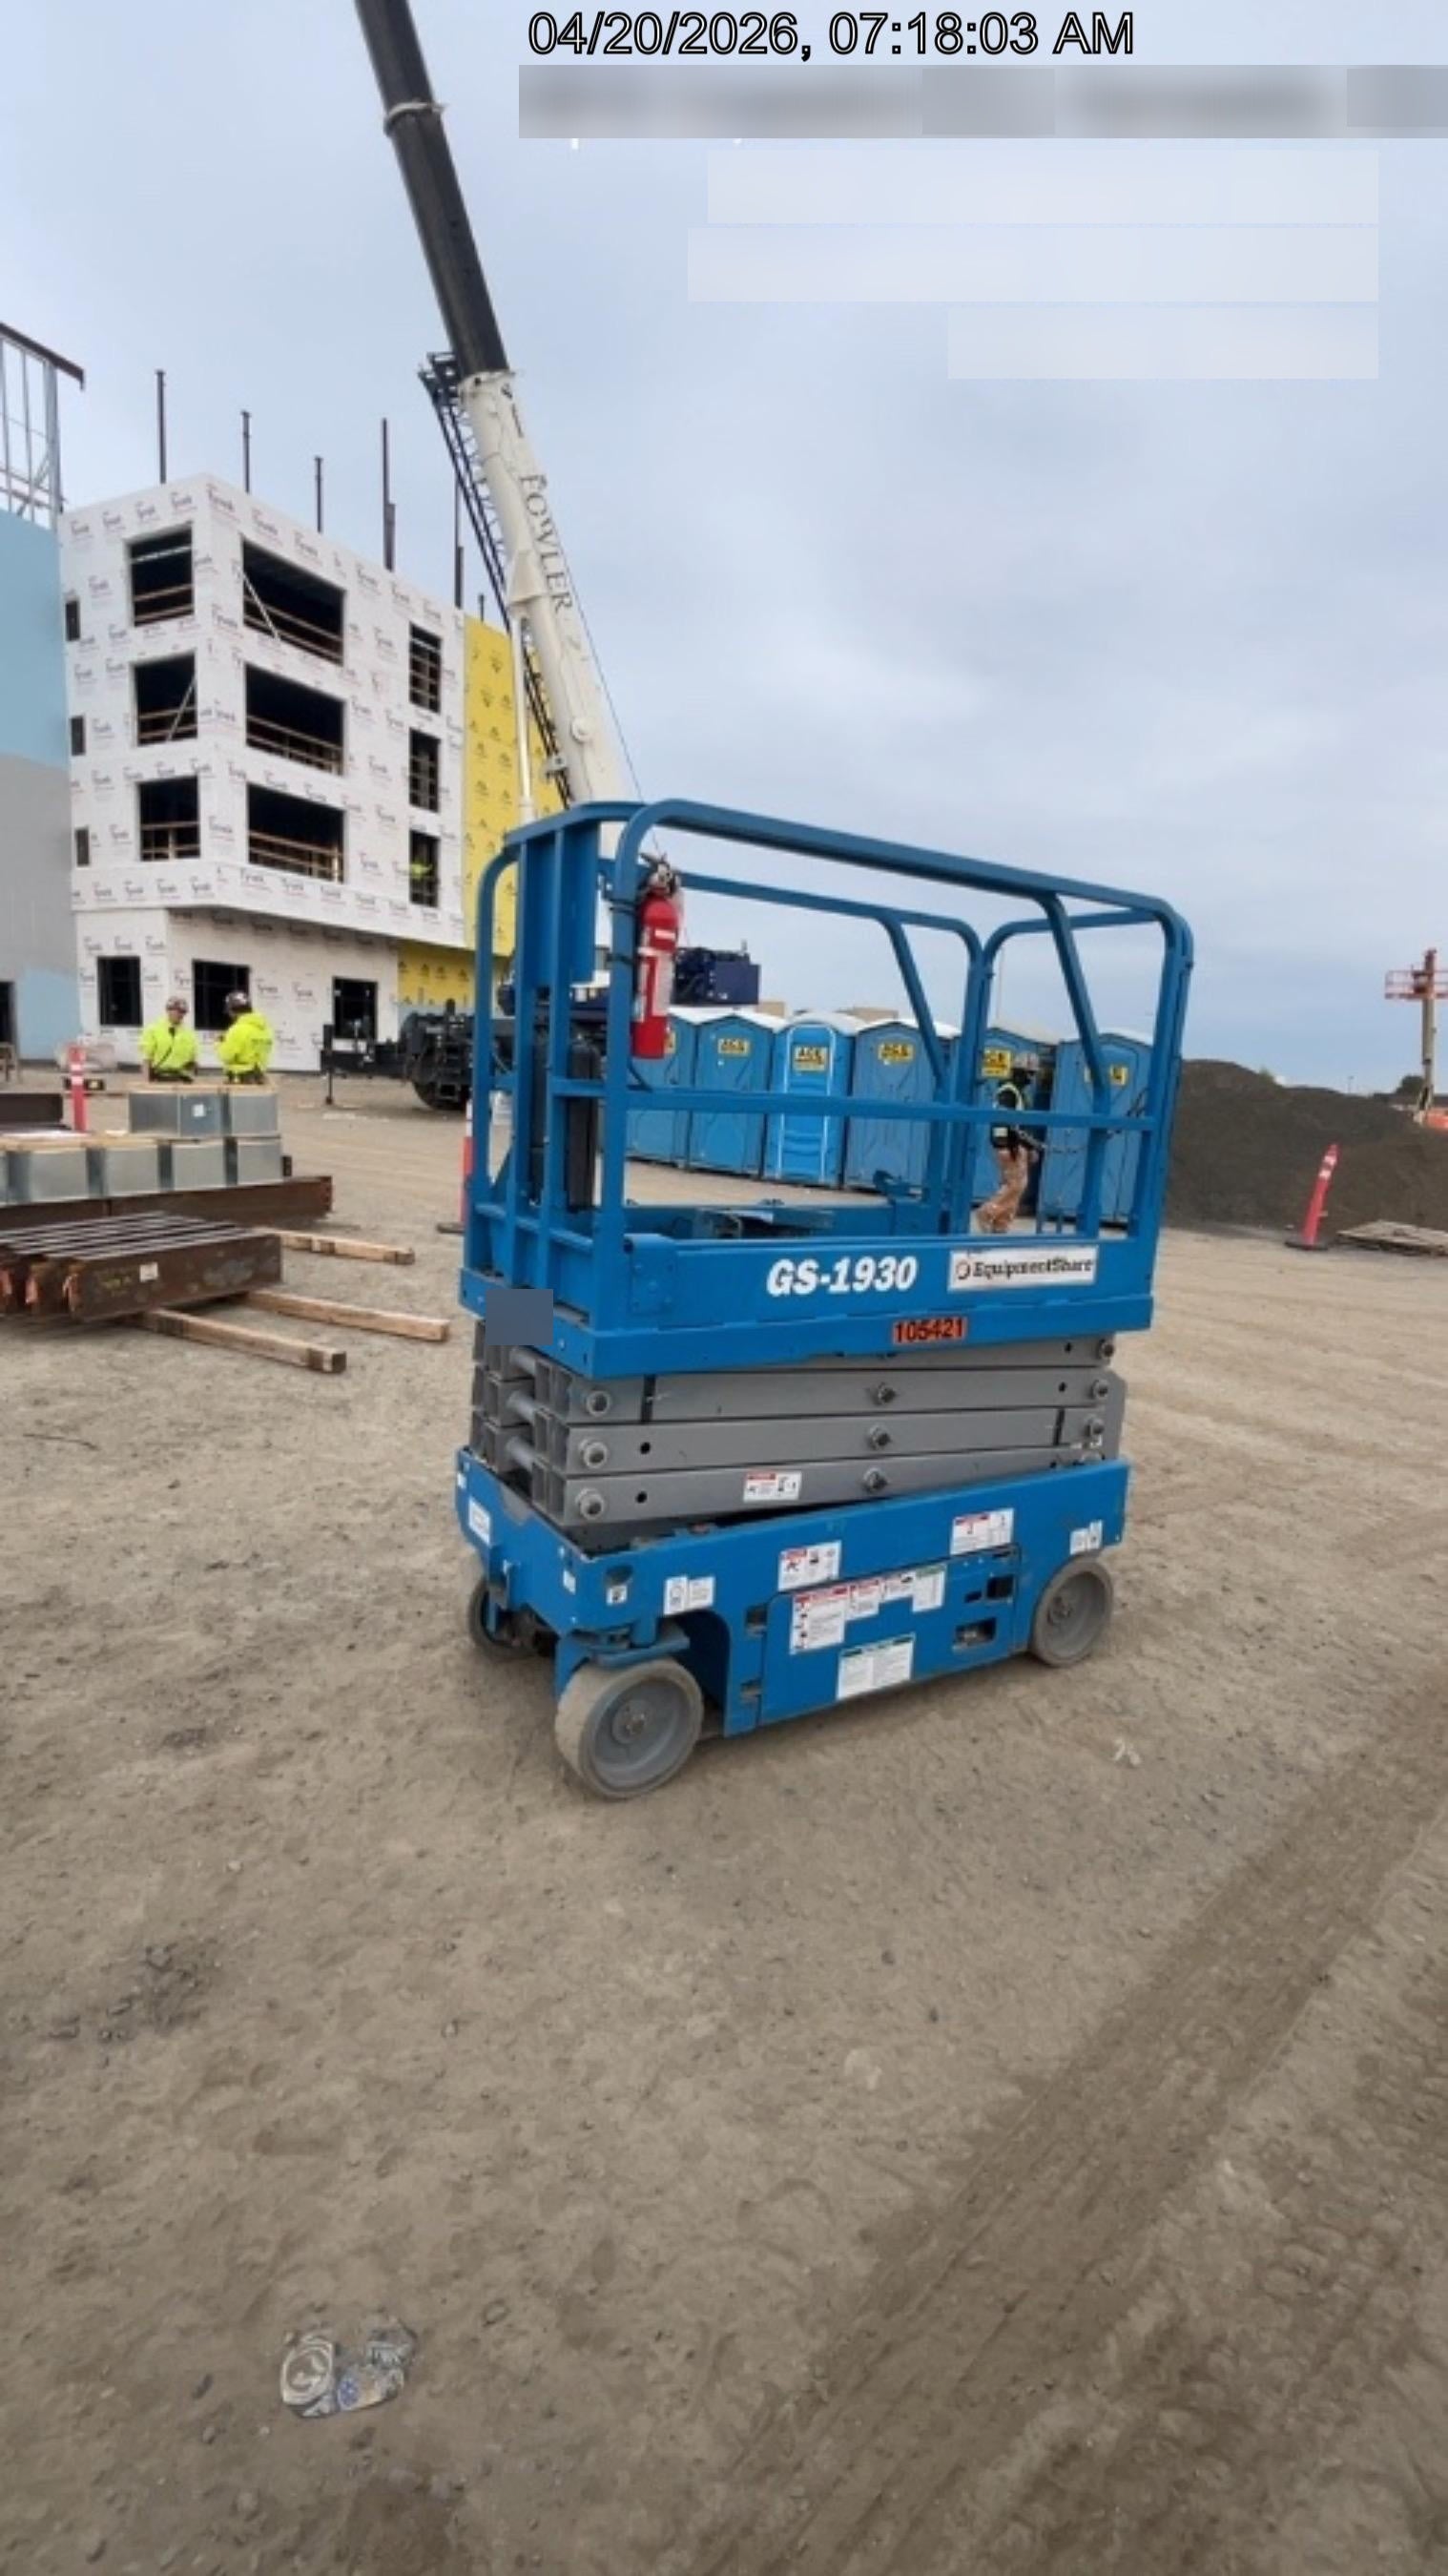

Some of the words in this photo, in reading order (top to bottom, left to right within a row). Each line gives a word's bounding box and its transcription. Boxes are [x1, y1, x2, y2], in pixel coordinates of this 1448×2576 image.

[520, 474, 572, 613] FOWLER
[766, 1256, 919, 1297] GS-1930
[895, 1317, 962, 1343] 105421
